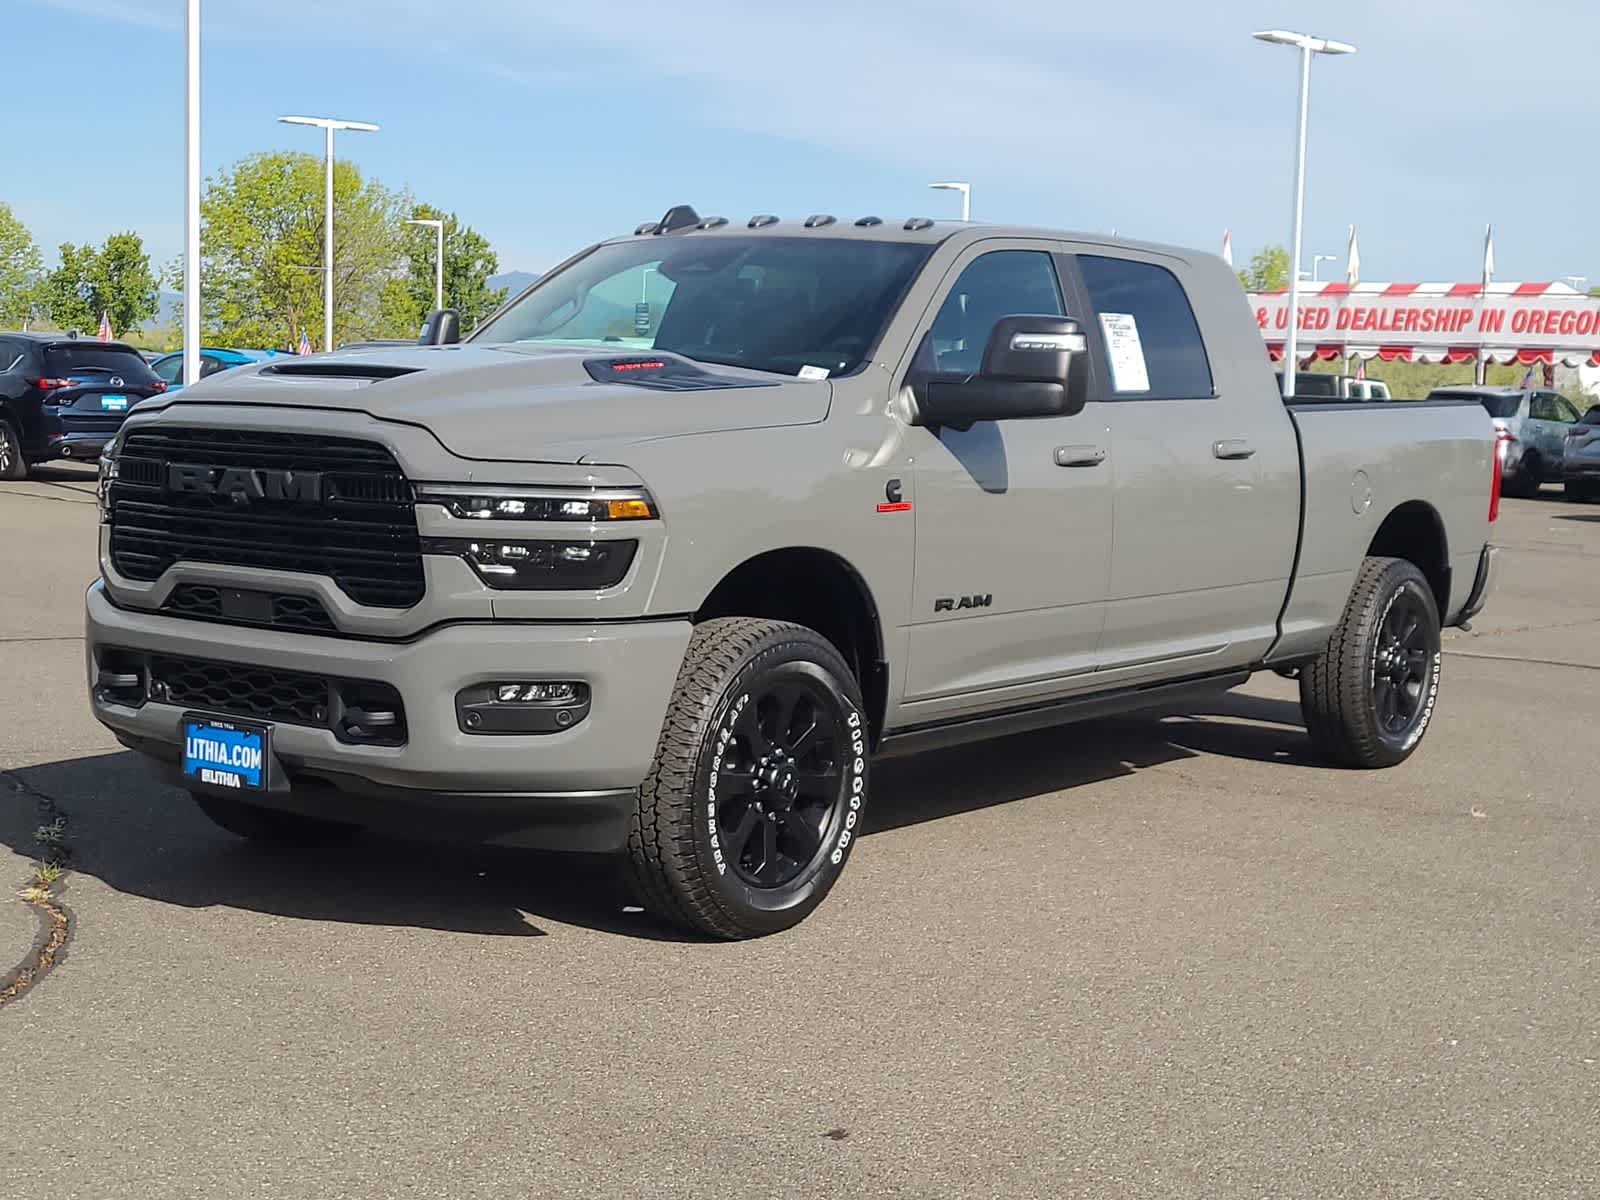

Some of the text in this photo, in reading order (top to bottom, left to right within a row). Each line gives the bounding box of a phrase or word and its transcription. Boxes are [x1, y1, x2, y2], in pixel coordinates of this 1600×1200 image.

[1256, 307, 1269, 329] &
[1336, 307, 1474, 333] DEALERSHIP
[1478, 309, 1506, 333] IN
[167, 463, 322, 502] RAM
[934, 594, 993, 612] RAM
[186, 737, 262, 769] LITHIA.COM
